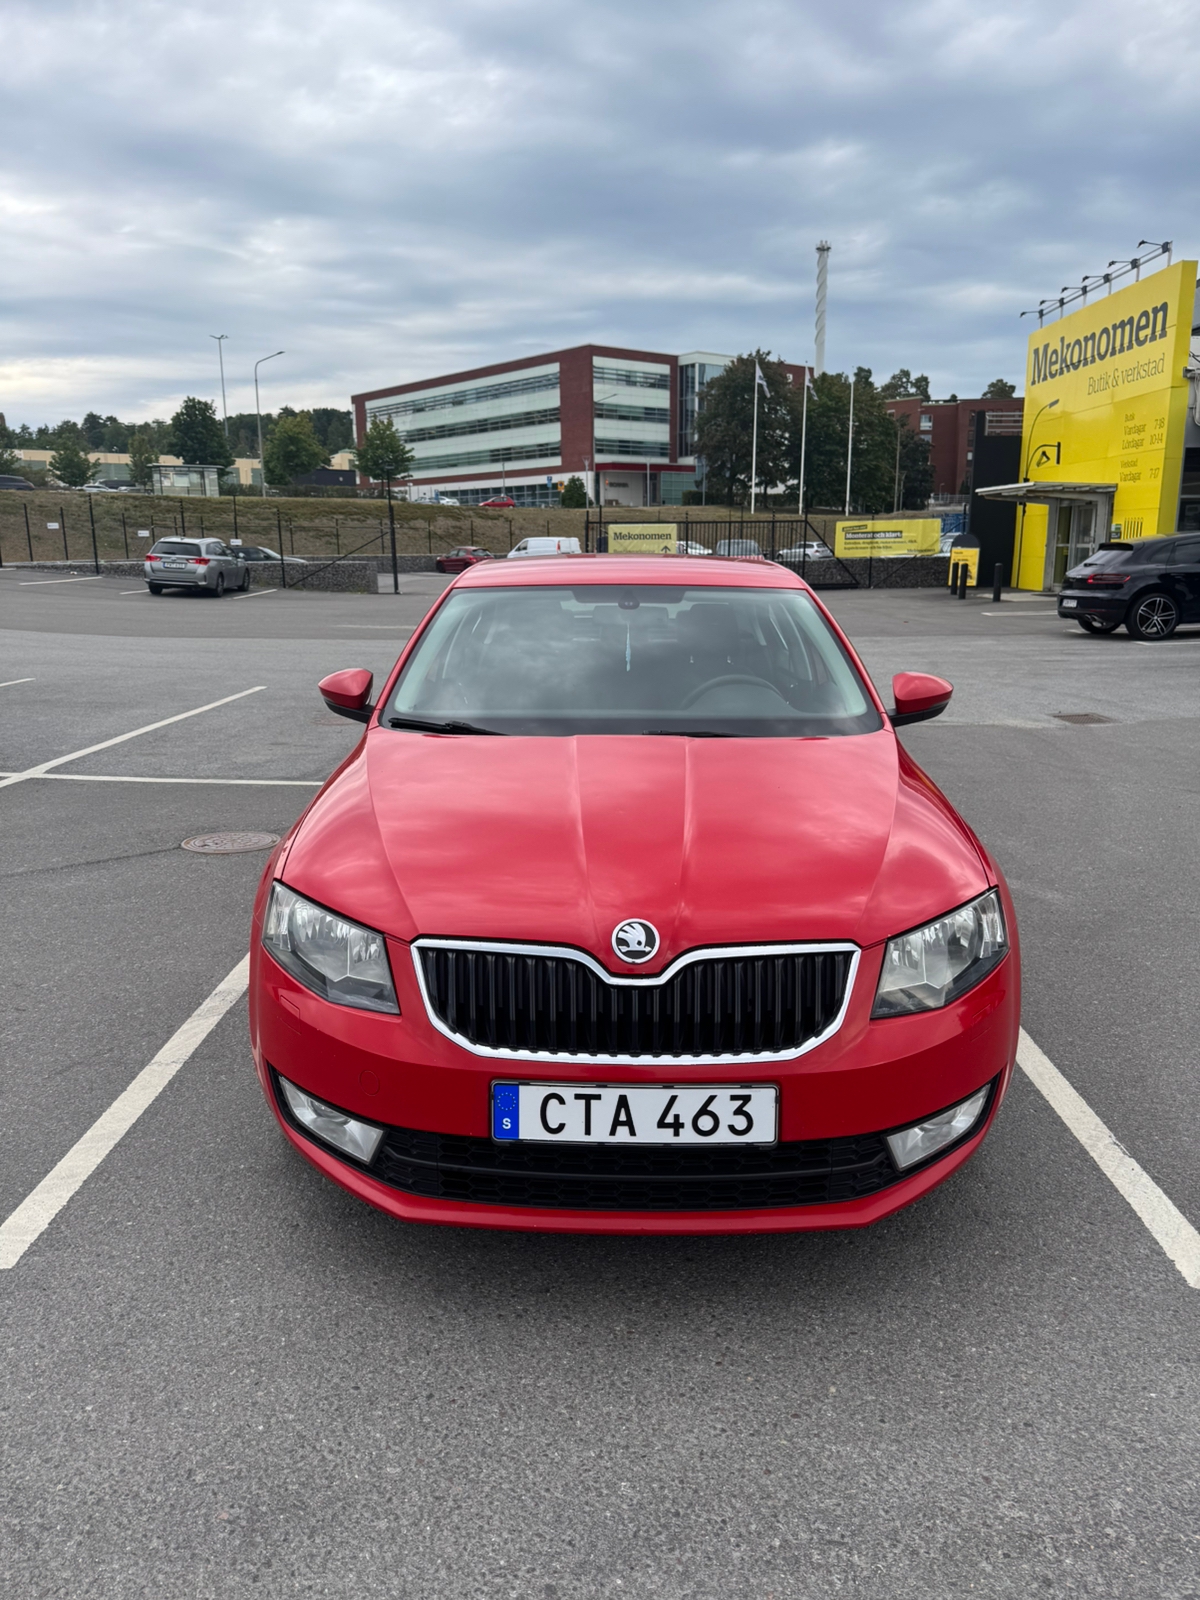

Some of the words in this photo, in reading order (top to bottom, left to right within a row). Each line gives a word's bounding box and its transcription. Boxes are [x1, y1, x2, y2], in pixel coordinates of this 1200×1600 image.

[1031, 302, 1168, 386] Mekonomen
[1087, 371, 1111, 395] Butik
[1112, 368, 1120, 388] &
[1121, 352, 1165, 385] verkstad
[613, 532, 672, 540] Mekonomen
[502, 1118, 512, 1130] S
[540, 1092, 637, 1137] CTA
[656, 1094, 754, 1137] 463
